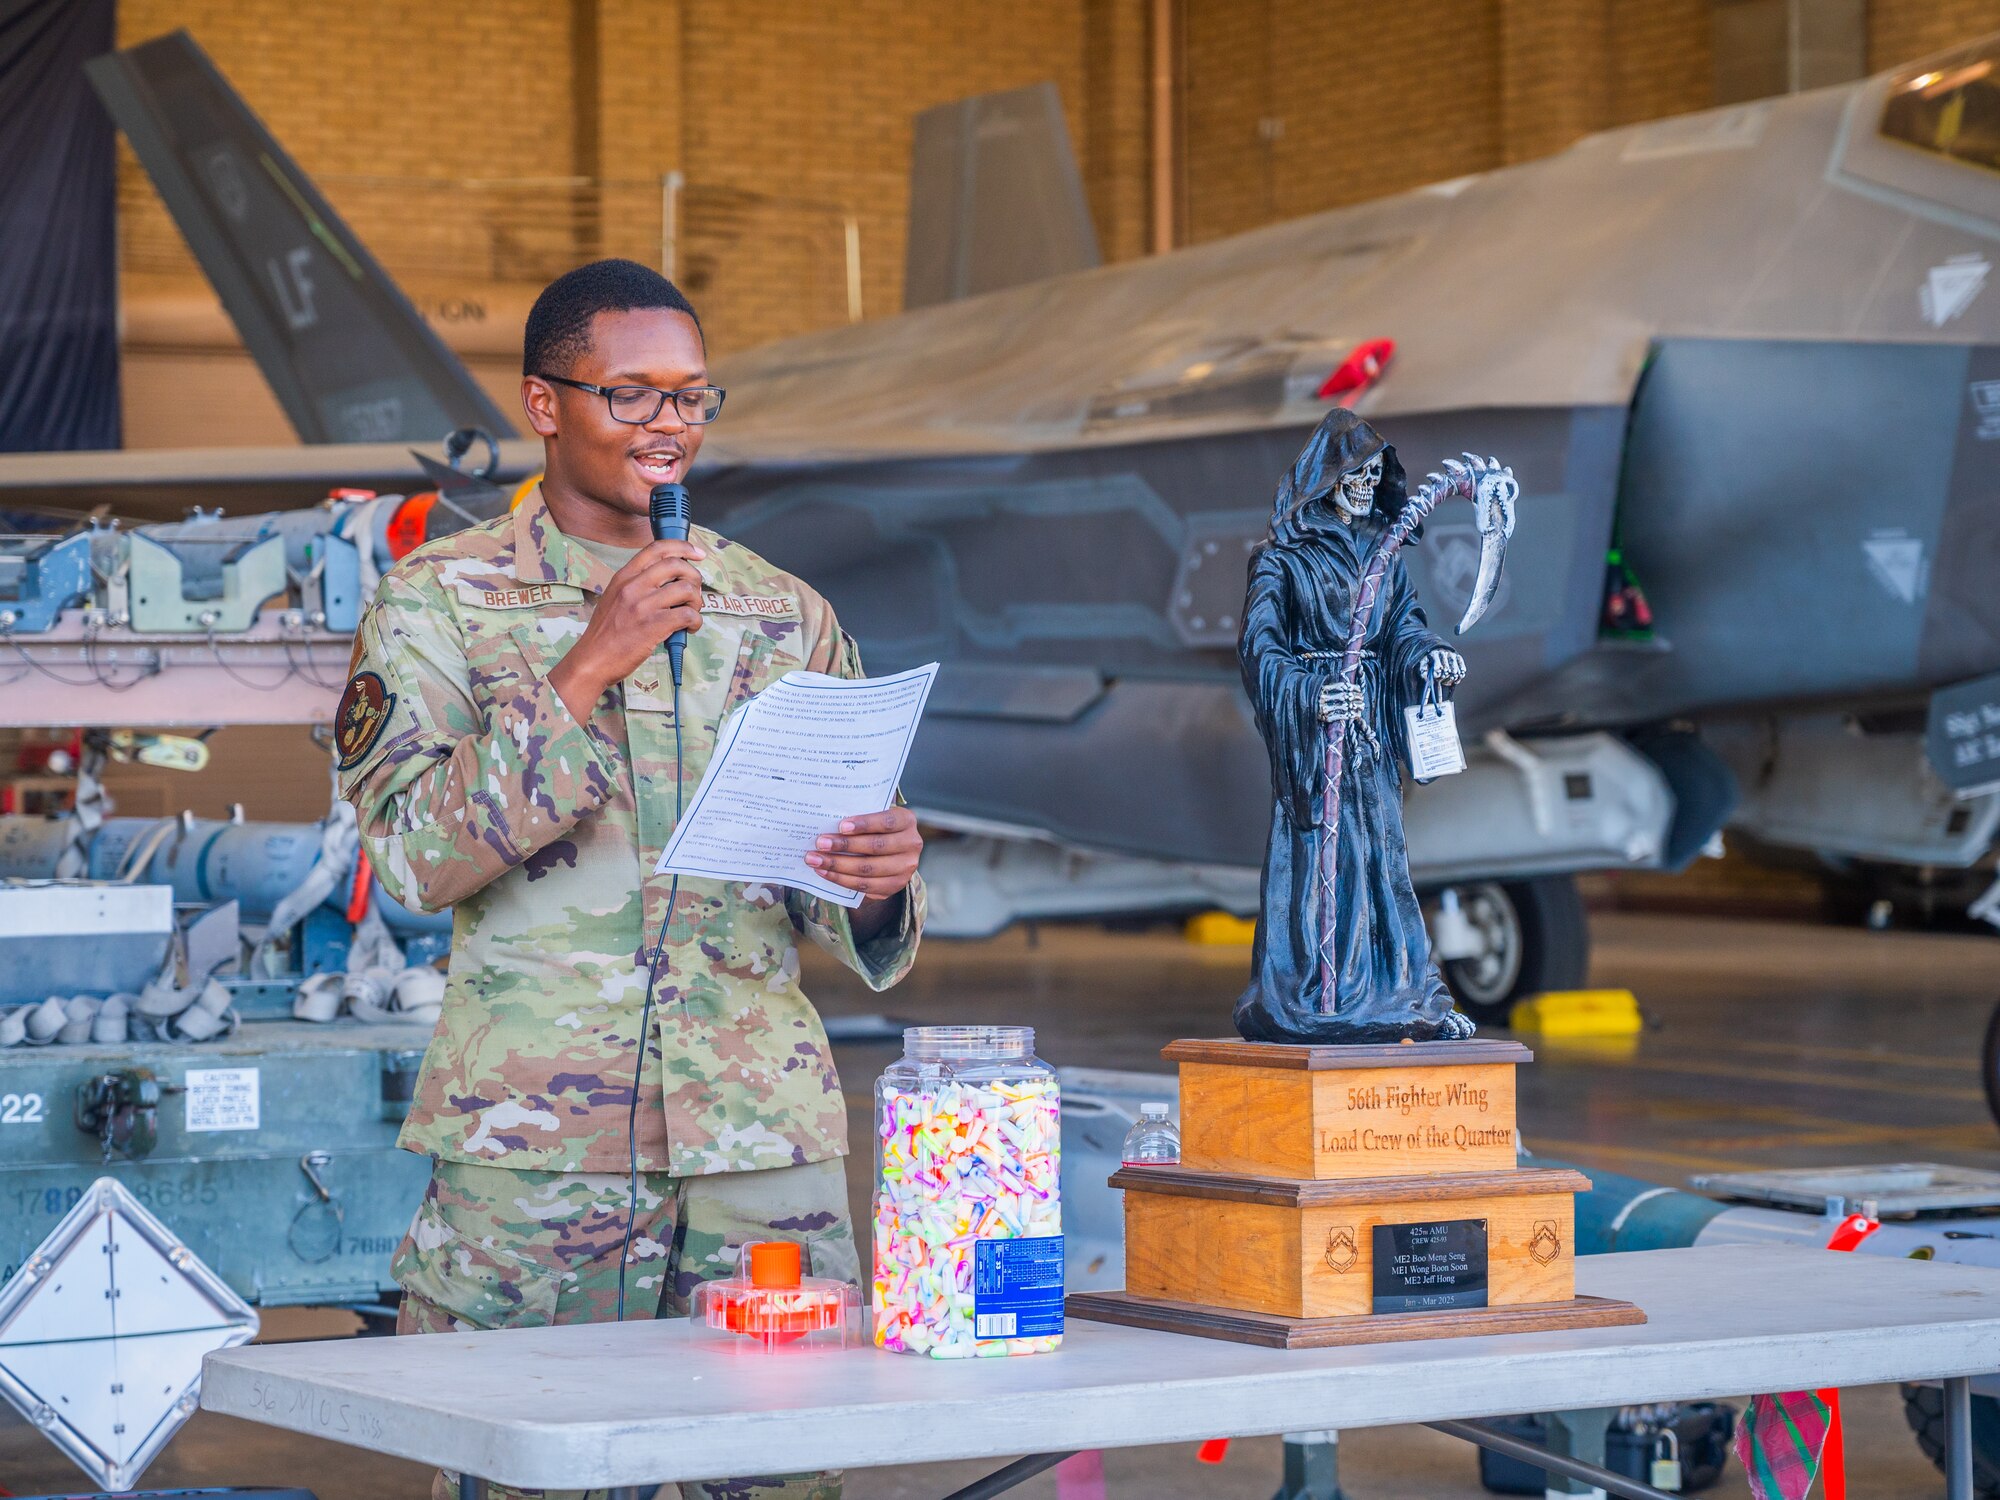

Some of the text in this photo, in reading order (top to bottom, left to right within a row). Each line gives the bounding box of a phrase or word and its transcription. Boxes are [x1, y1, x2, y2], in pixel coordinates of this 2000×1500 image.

[484, 584, 552, 606] BREWER
[723, 596, 744, 613] AIR
[744, 598, 793, 614] FORCE
[204, 1073, 240, 1081] CAUTION
[1347, 1082, 1488, 1116] 56th Fighter Wing
[0, 1093, 43, 1123] 22
[1320, 1124, 1511, 1154] Load Crew of the Quarter
[1430, 1226, 1448, 1235] AMU
[1394, 1252, 1466, 1264] ME2 Boo Meng Seng
[1392, 1263, 1468, 1275] ME1 Wong Boon Soon
[1404, 1275, 1455, 1285] ME2 Jeff Hong
[1404, 1298, 1416, 1307] Jan
[1422, 1297, 1437, 1306] Mar
[1438, 1296, 1454, 1304] 2025
